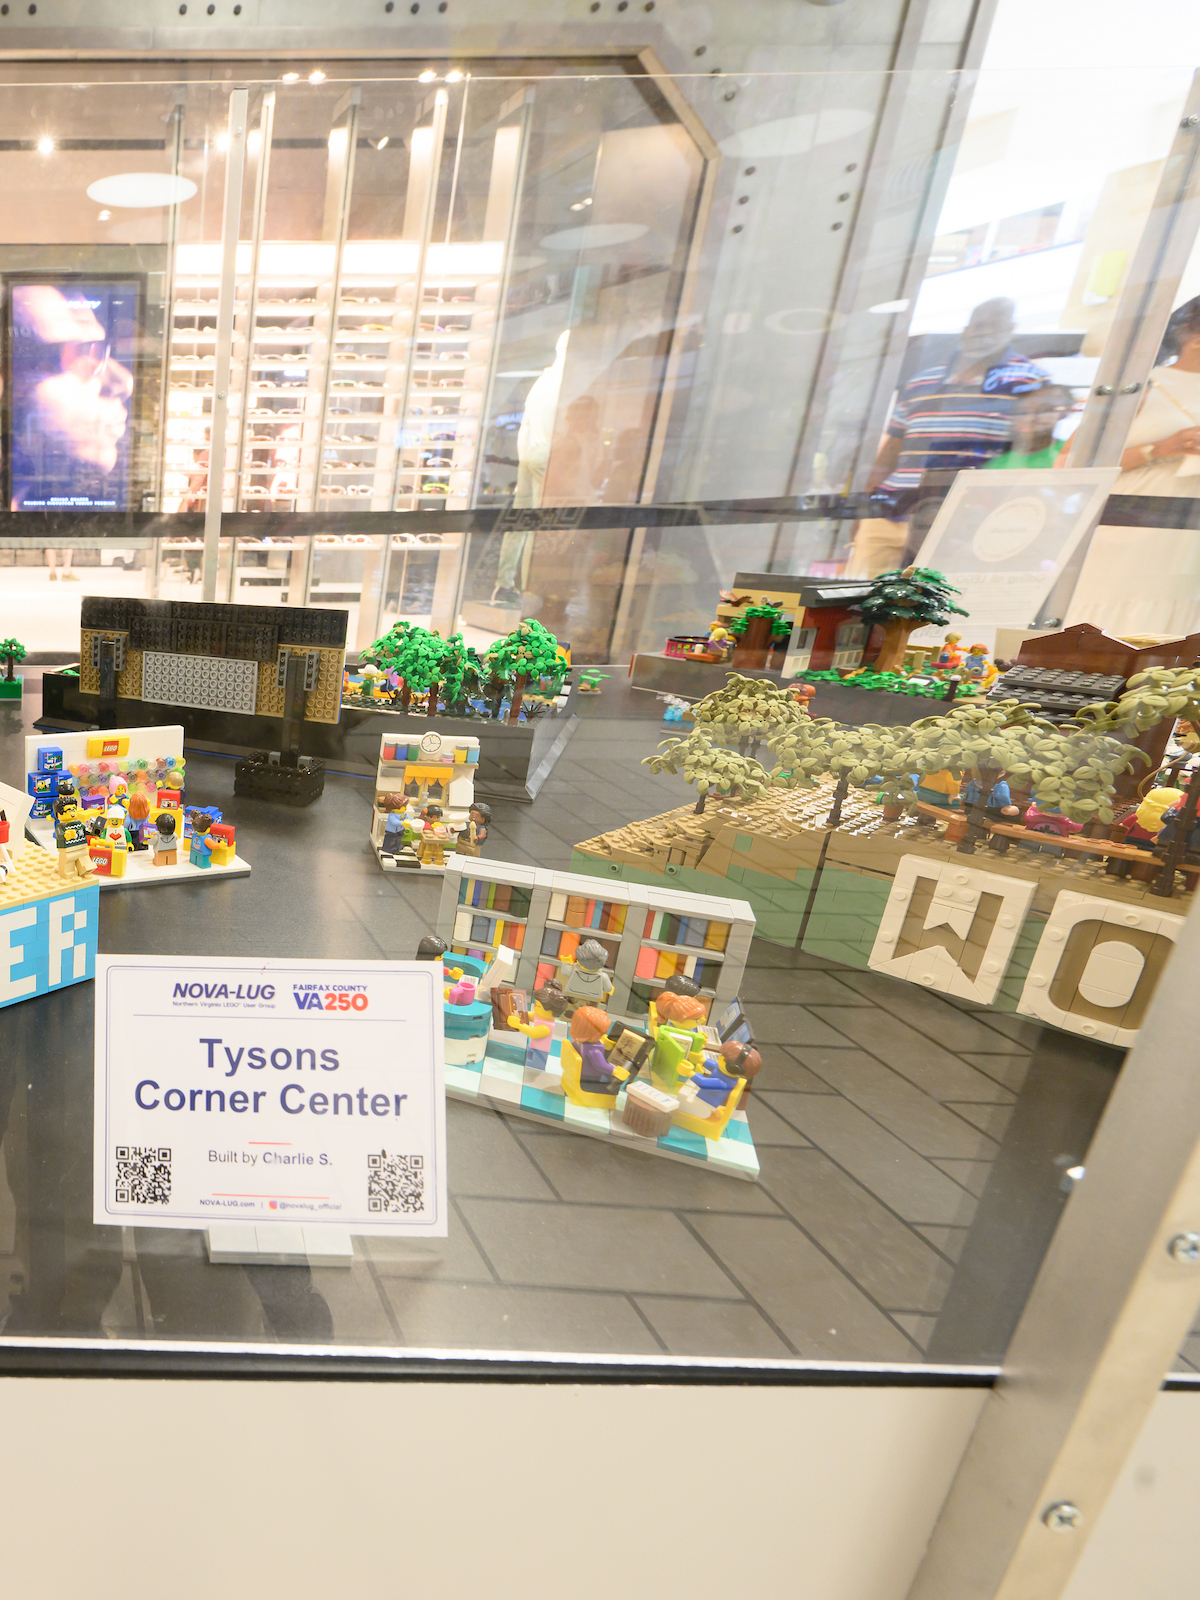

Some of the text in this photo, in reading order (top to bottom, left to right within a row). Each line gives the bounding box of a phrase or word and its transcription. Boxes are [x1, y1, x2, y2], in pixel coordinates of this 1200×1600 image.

[103, 744, 118, 752] LEGO
[92, 857, 108, 865] LEGO
[172, 983, 275, 999] NOVA-LUG
[293, 992, 368, 1011] VA250
[199, 1038, 339, 1078] Tysons
[135, 1080, 408, 1117] Corner Center
[208, 1150, 332, 1167] Built by Charlie S.
[200, 1199, 341, 1211] NOVA-LUG.com @novalug_official
